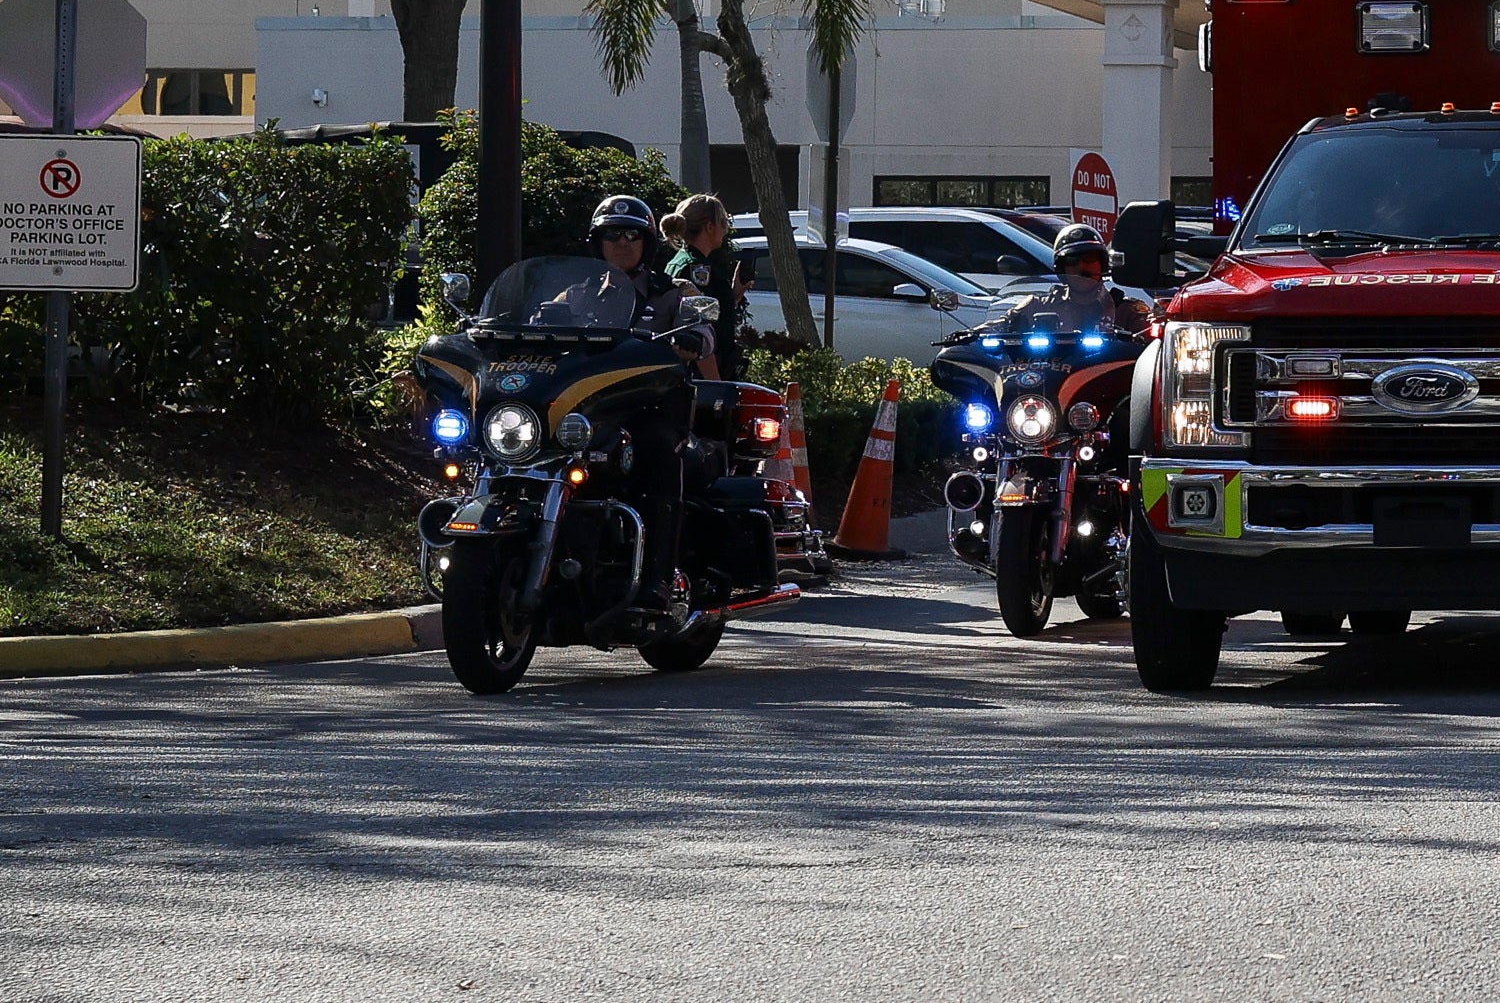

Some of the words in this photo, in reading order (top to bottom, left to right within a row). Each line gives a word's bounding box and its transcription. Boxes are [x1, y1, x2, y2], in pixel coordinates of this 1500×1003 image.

[1077, 170, 1089, 186] DO
[1094, 174, 1111, 190] NOT
[3, 203, 25, 215] NO
[29, 203, 93, 216] PARKING
[97, 204, 115, 216] AT
[72, 218, 124, 231] OFFICE
[1081, 215, 1108, 234] ENTER
[10, 232, 74, 244] PARKING
[78, 233, 108, 245] LOT.
[11, 248, 18, 256] It
[19, 248, 26, 256] is
[28, 248, 48, 257] NOT
[50, 248, 86, 257] affiliated
[88, 249, 106, 258] with
[10, 257, 40, 266] Florida
[42, 258, 88, 267] Lawnwood
[89, 258, 128, 268] Hospital.
[506, 354, 553, 363] STATE
[487, 361, 558, 376] TROOPER
[999, 361, 1073, 375] TROOPER
[1399, 376, 1450, 397] Ford
